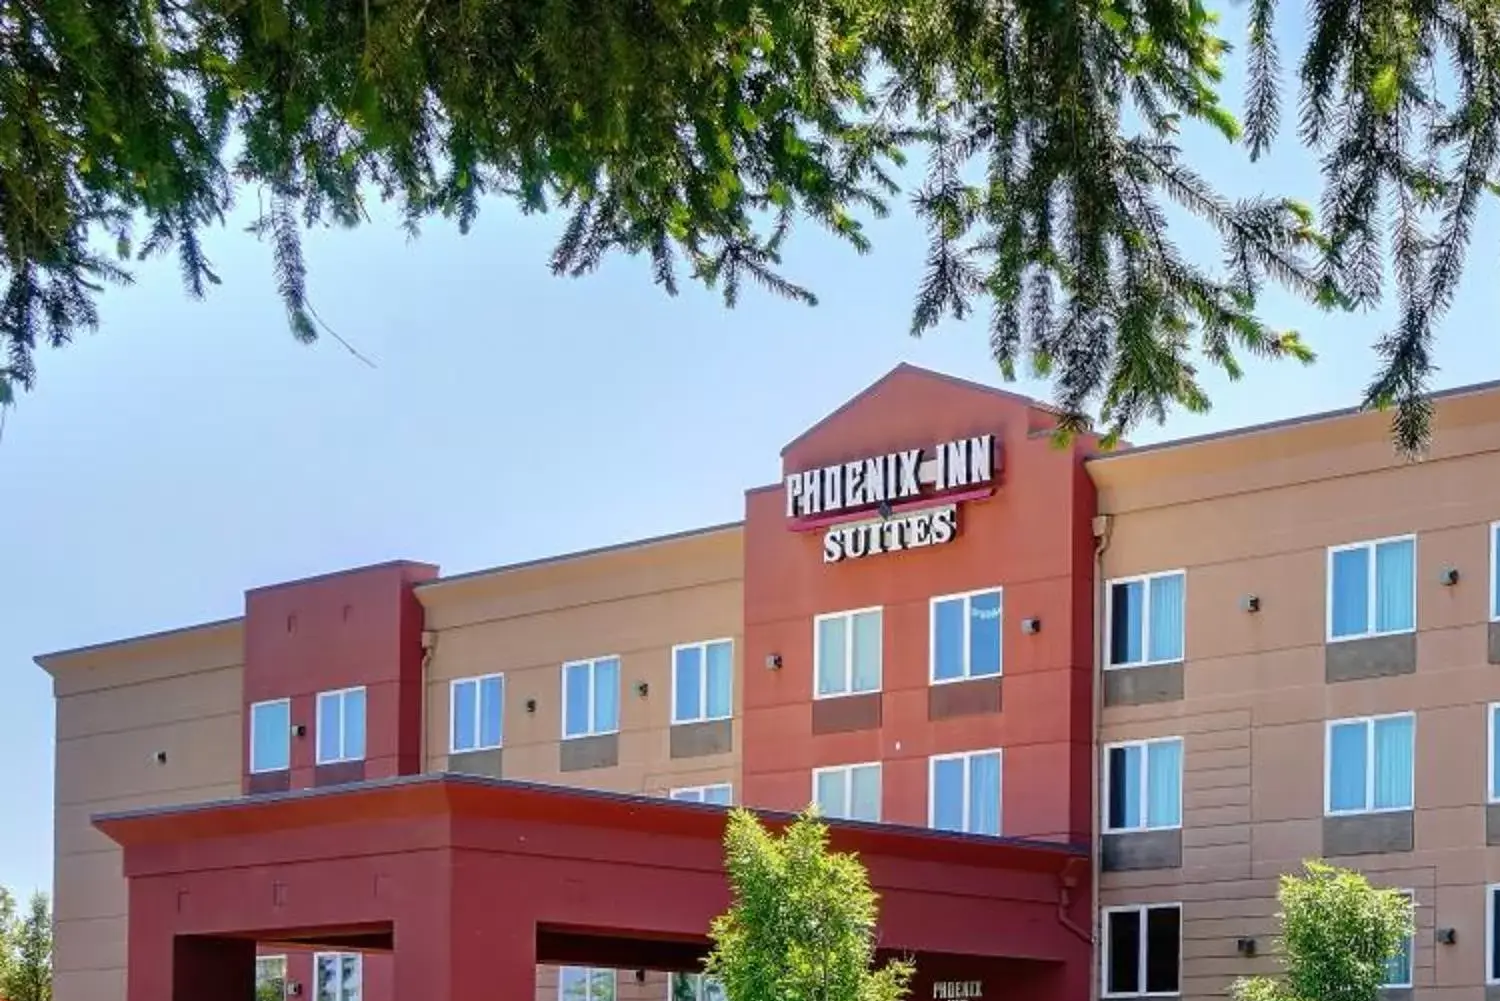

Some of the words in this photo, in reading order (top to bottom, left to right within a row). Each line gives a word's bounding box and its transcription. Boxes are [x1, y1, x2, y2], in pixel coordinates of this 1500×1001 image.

[786, 449, 922, 517] PHOENIX
[935, 434, 994, 490] INN
[823, 509, 957, 562] SUITES
[933, 981, 983, 999] PHOENIX
